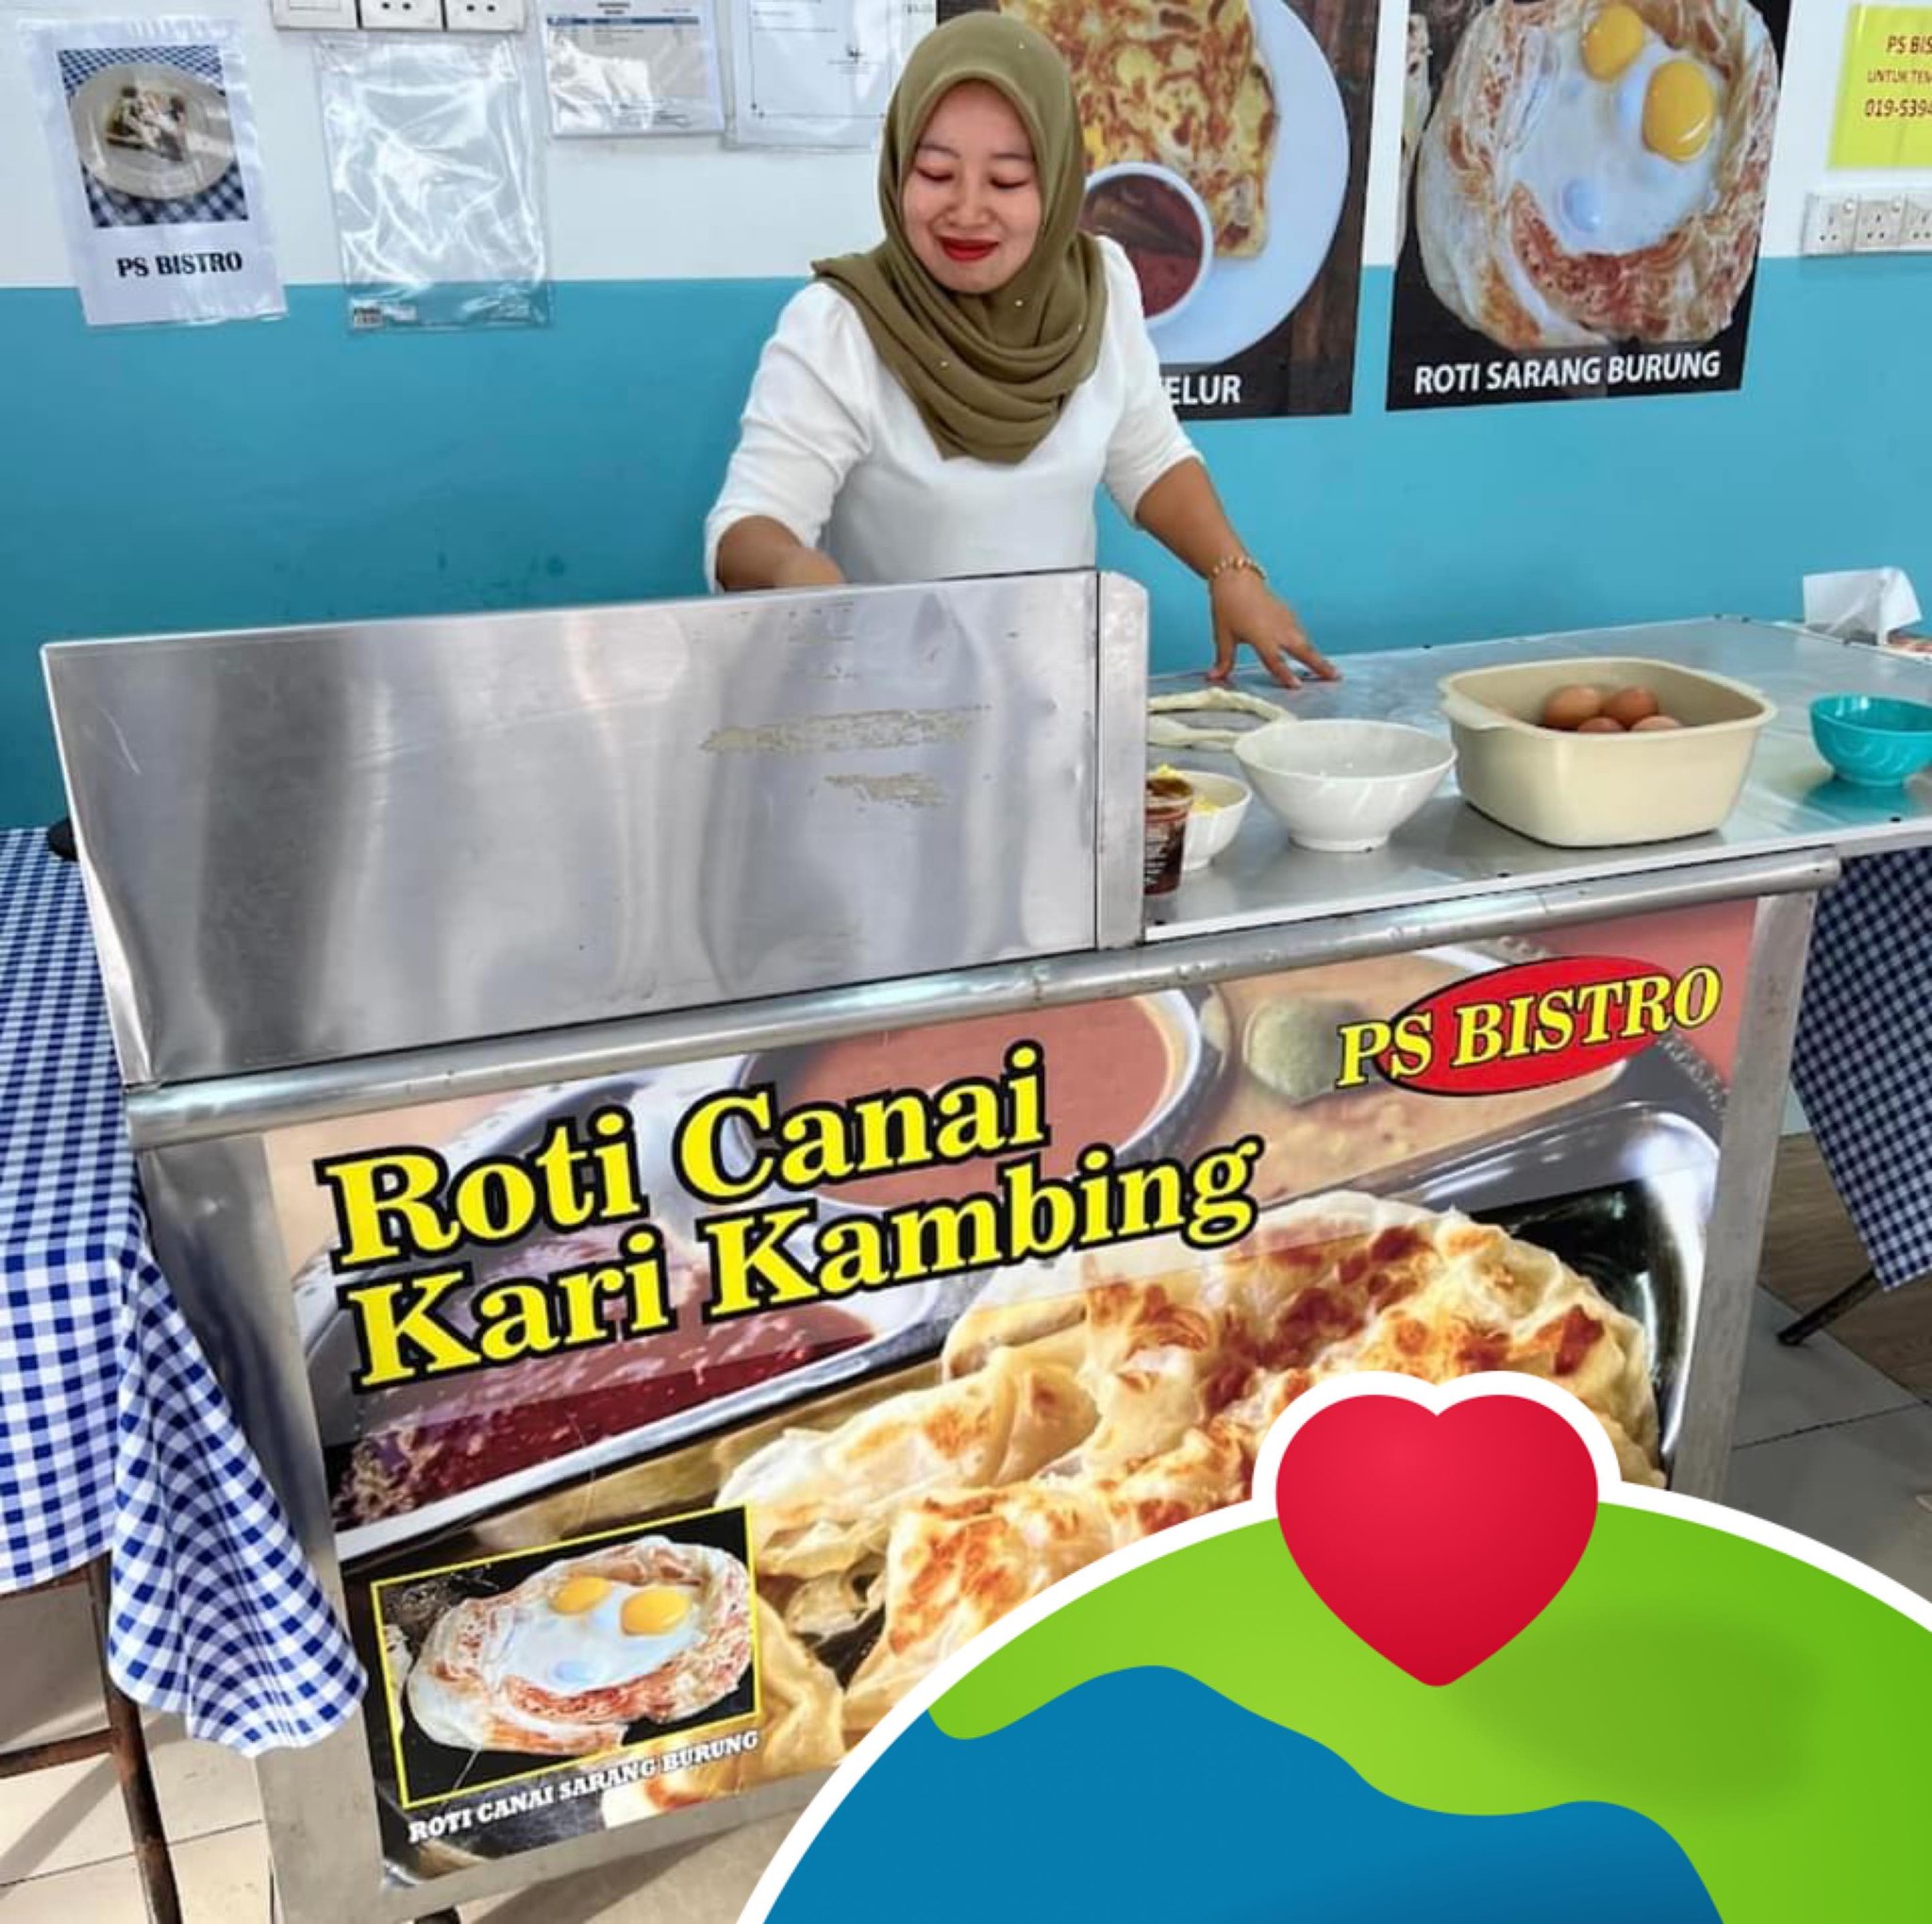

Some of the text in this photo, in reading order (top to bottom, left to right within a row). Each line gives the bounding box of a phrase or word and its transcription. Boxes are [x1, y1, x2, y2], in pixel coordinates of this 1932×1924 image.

[1886, 35, 1907, 54] PS
[117, 251, 242, 277] PS BISTRO
[1160, 373, 1241, 406] ELUR
[1415, 349, 1722, 394] ROTI SARANG BURUNG
[1336, 965, 1724, 1089] PS BISTRO
[321, 1046, 1043, 1268] Roti Canai
[347, 1138, 1260, 1388] Kari Kambing
[408, 1730, 758, 1844] ROTI CANAI SARANG BURUNG
